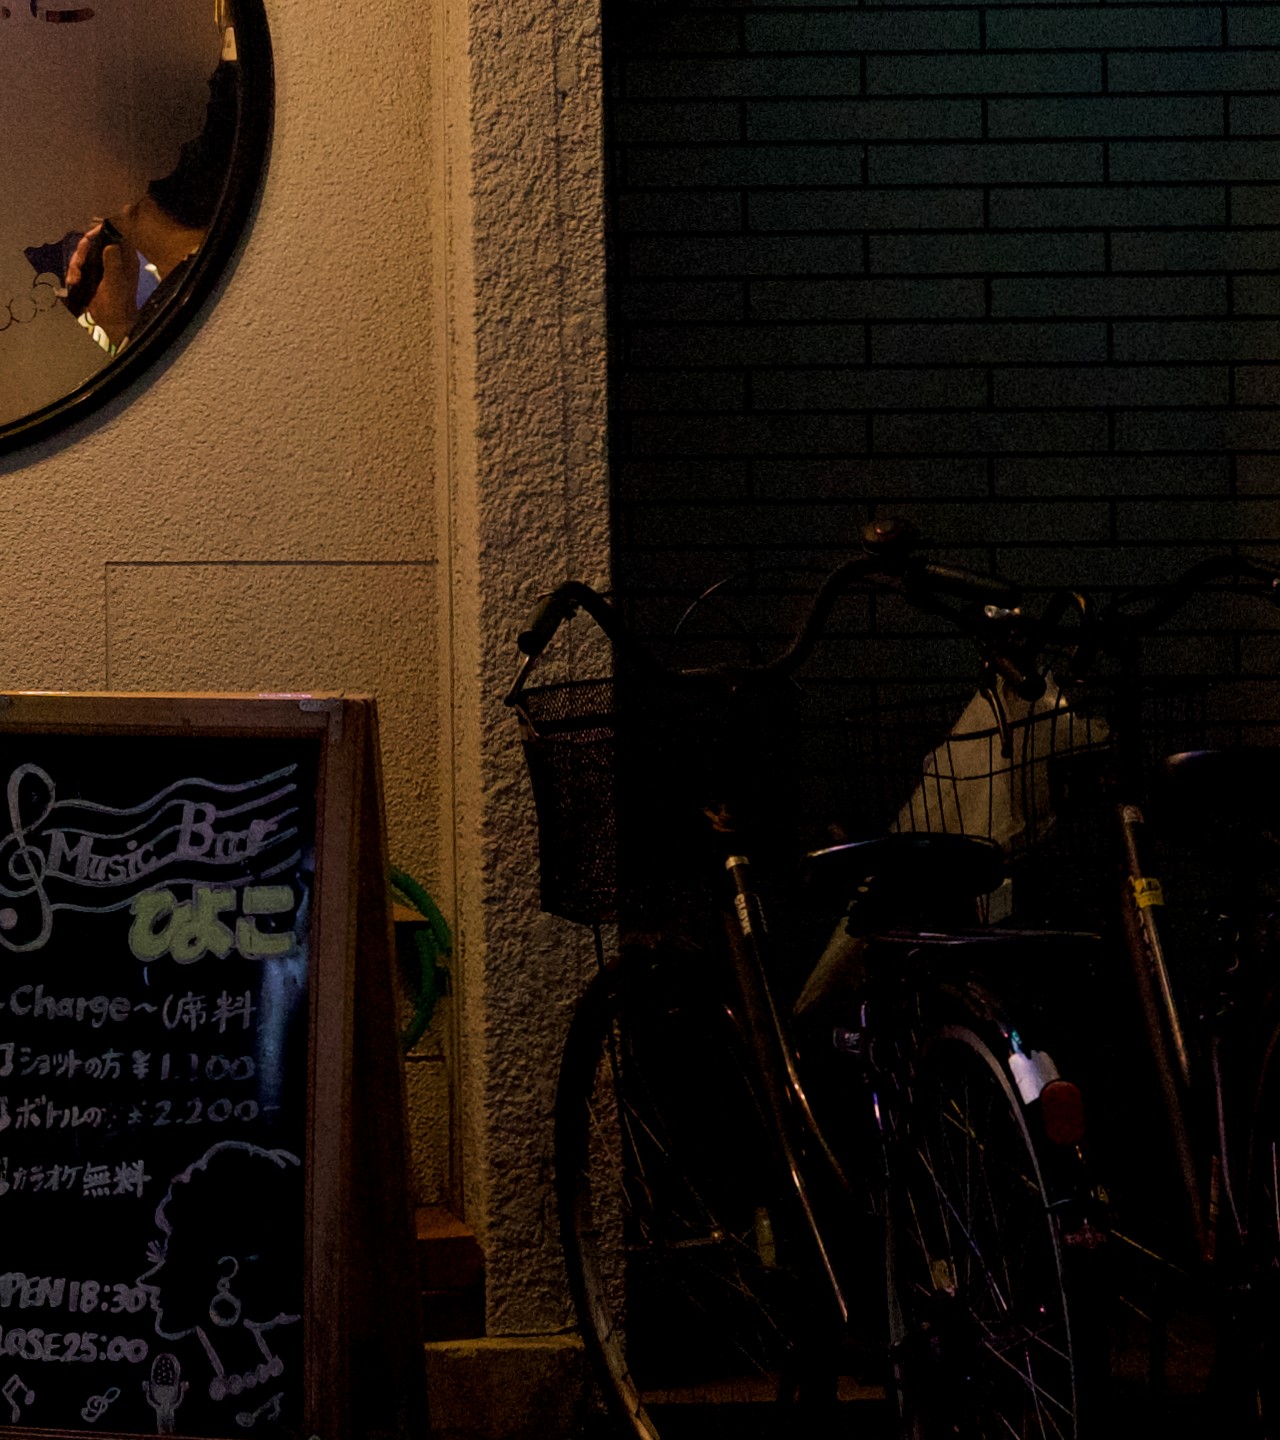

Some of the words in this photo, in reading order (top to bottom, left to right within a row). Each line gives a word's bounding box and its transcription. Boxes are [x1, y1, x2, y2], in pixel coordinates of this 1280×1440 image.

[41, 829, 158, 883] Music
[127, 885, 297, 966] ひよこ
[11, 1159, 153, 1198] カラオケ無料
[68, 1280, 151, 1313] 18:30
[61, 1331, 150, 1364] 25:00
